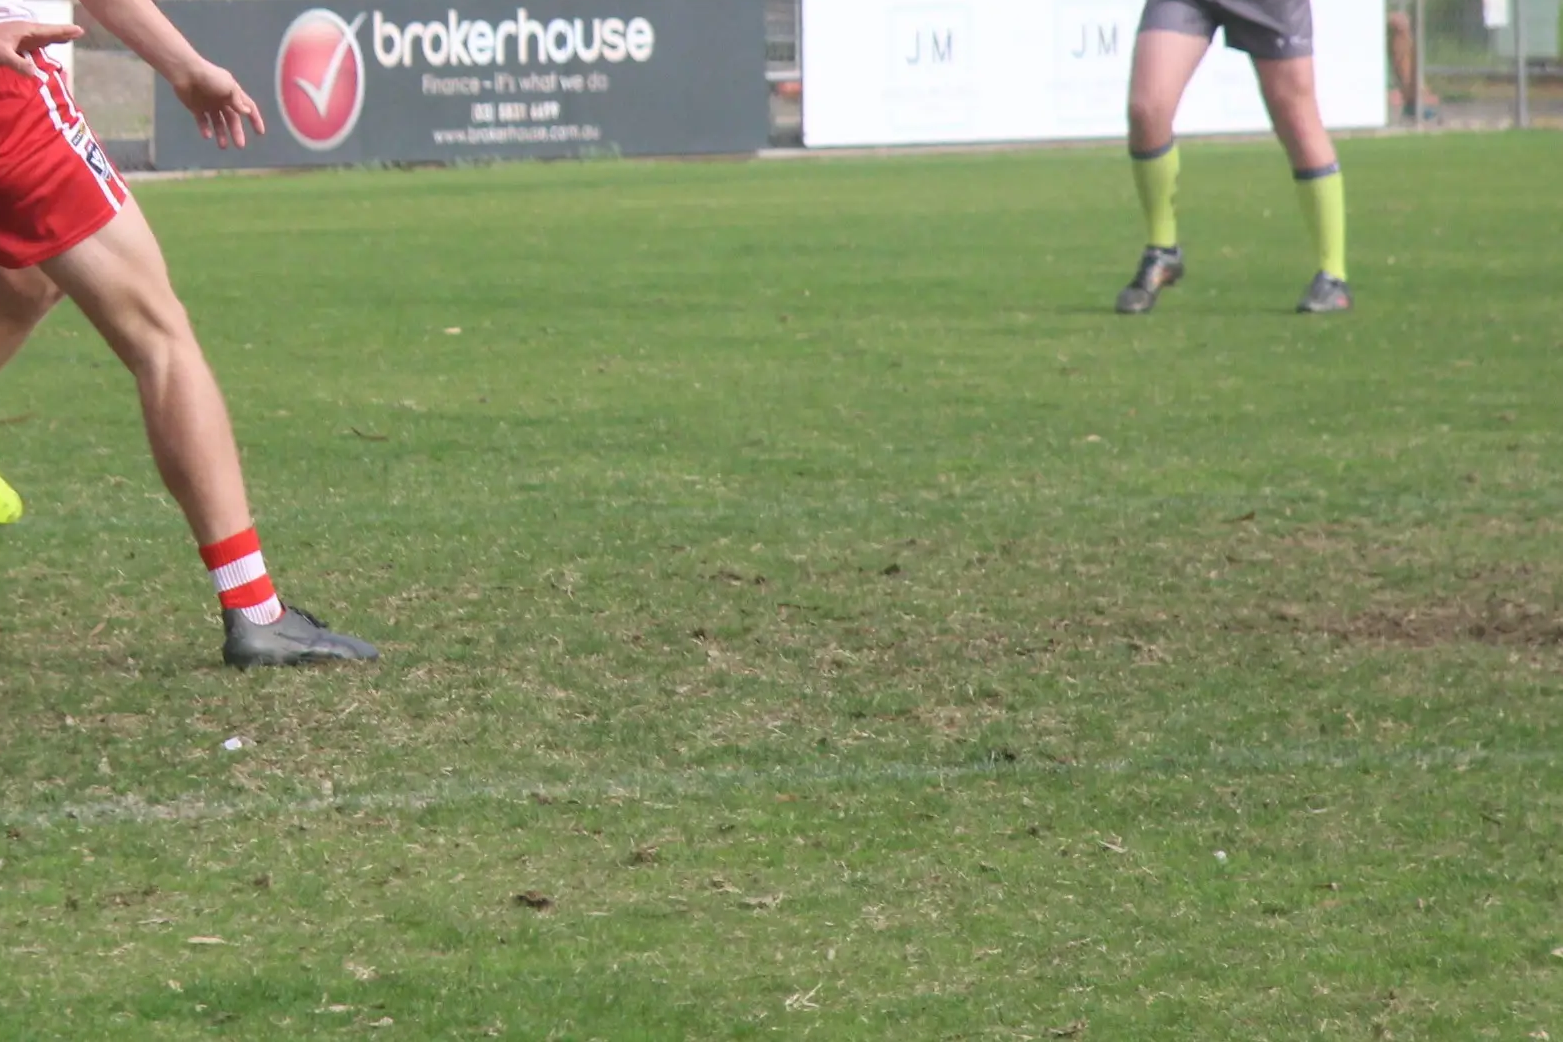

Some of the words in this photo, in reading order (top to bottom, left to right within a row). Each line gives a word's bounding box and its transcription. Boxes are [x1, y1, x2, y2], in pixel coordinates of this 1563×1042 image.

[373, 7, 654, 67] brokerhouse
[519, 71, 558, 94] what
[559, 74, 585, 94] we
[587, 70, 609, 93] do
